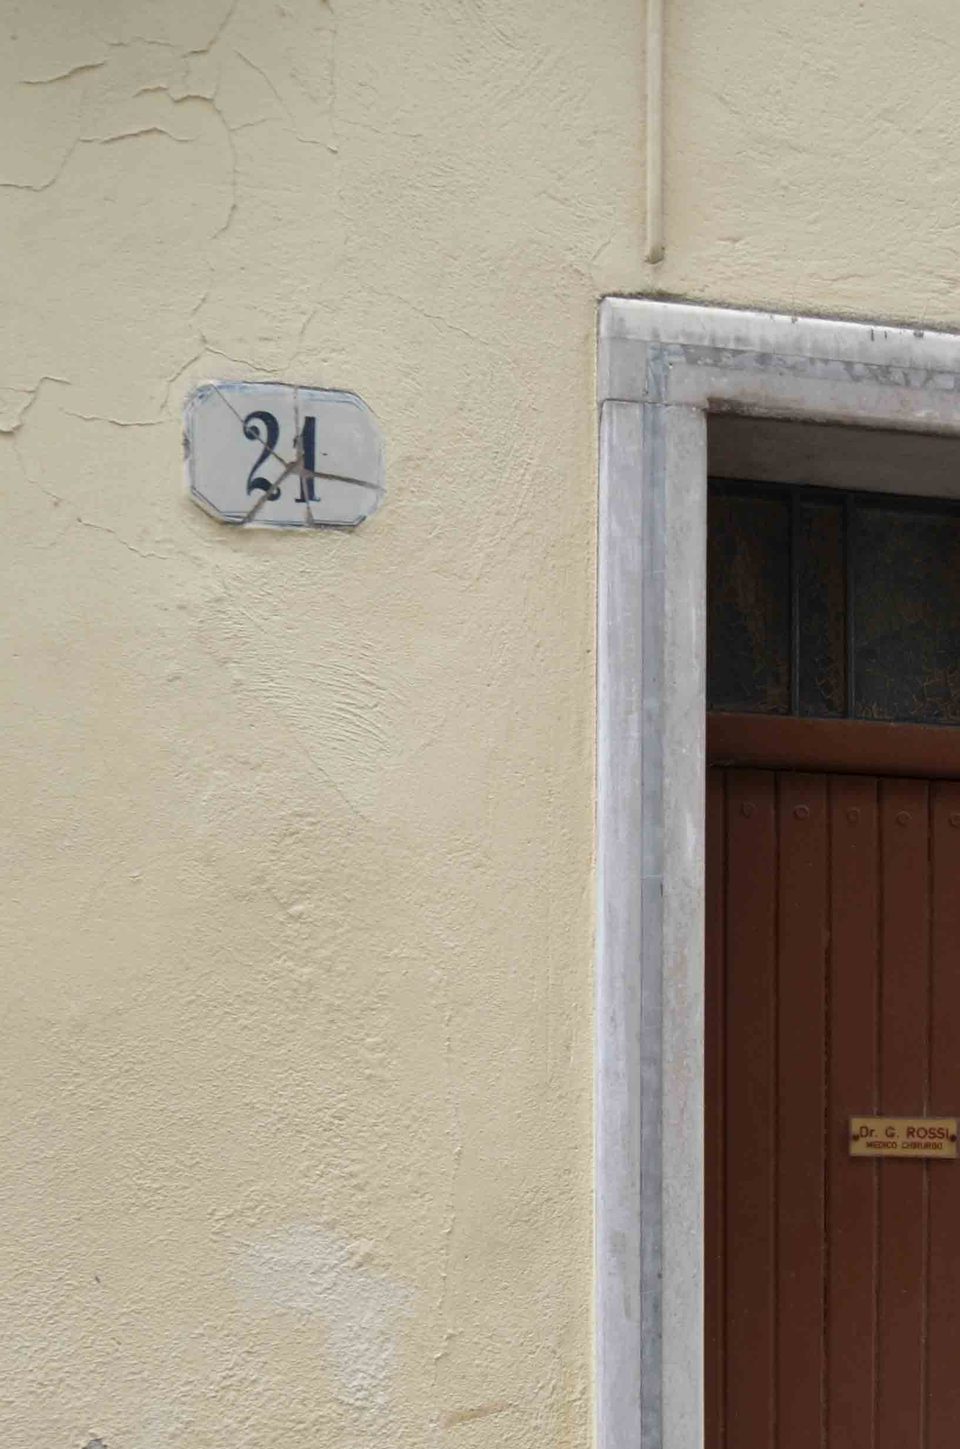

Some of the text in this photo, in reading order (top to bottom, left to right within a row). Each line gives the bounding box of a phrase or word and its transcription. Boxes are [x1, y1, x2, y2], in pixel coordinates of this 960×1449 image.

[243, 410, 321, 503] 21
[859, 1126, 949, 1139] Dr. G. ROSSI
[866, 1140, 897, 1149] MEDICO
